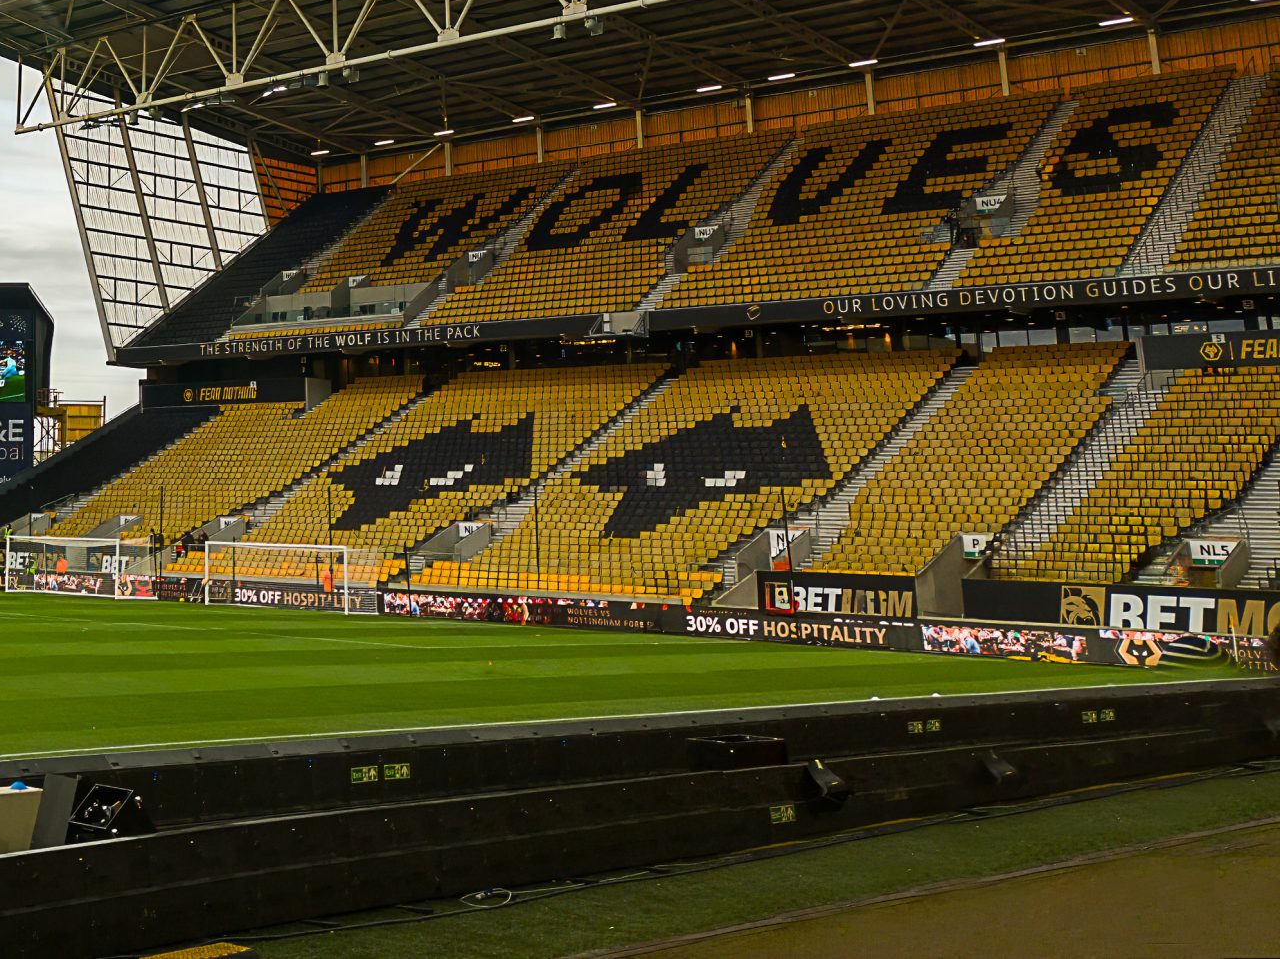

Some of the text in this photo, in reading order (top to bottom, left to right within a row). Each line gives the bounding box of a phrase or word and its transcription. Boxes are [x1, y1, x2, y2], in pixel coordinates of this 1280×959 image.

[823, 298, 862, 314] OUR
[872, 292, 948, 311] LOVING
[960, 284, 1074, 305] DEVOTION
[1086, 277, 1176, 297] GUIDES
[1189, 273, 1240, 290] OUR
[200, 325, 480, 356] THE STRENGTH OF THE WOLF IS IN THE PACK
[1241, 339, 1280, 360] FEA
[1200, 544, 1229, 556] NL5
[234, 589, 257, 602] 30%
[260, 591, 282, 604] OFF
[567, 608, 611, 617] WOLVES VS
[567, 617, 621, 627] NOTTINGHAM
[686, 615, 886, 644] 30% OFF HOSPITALITY
